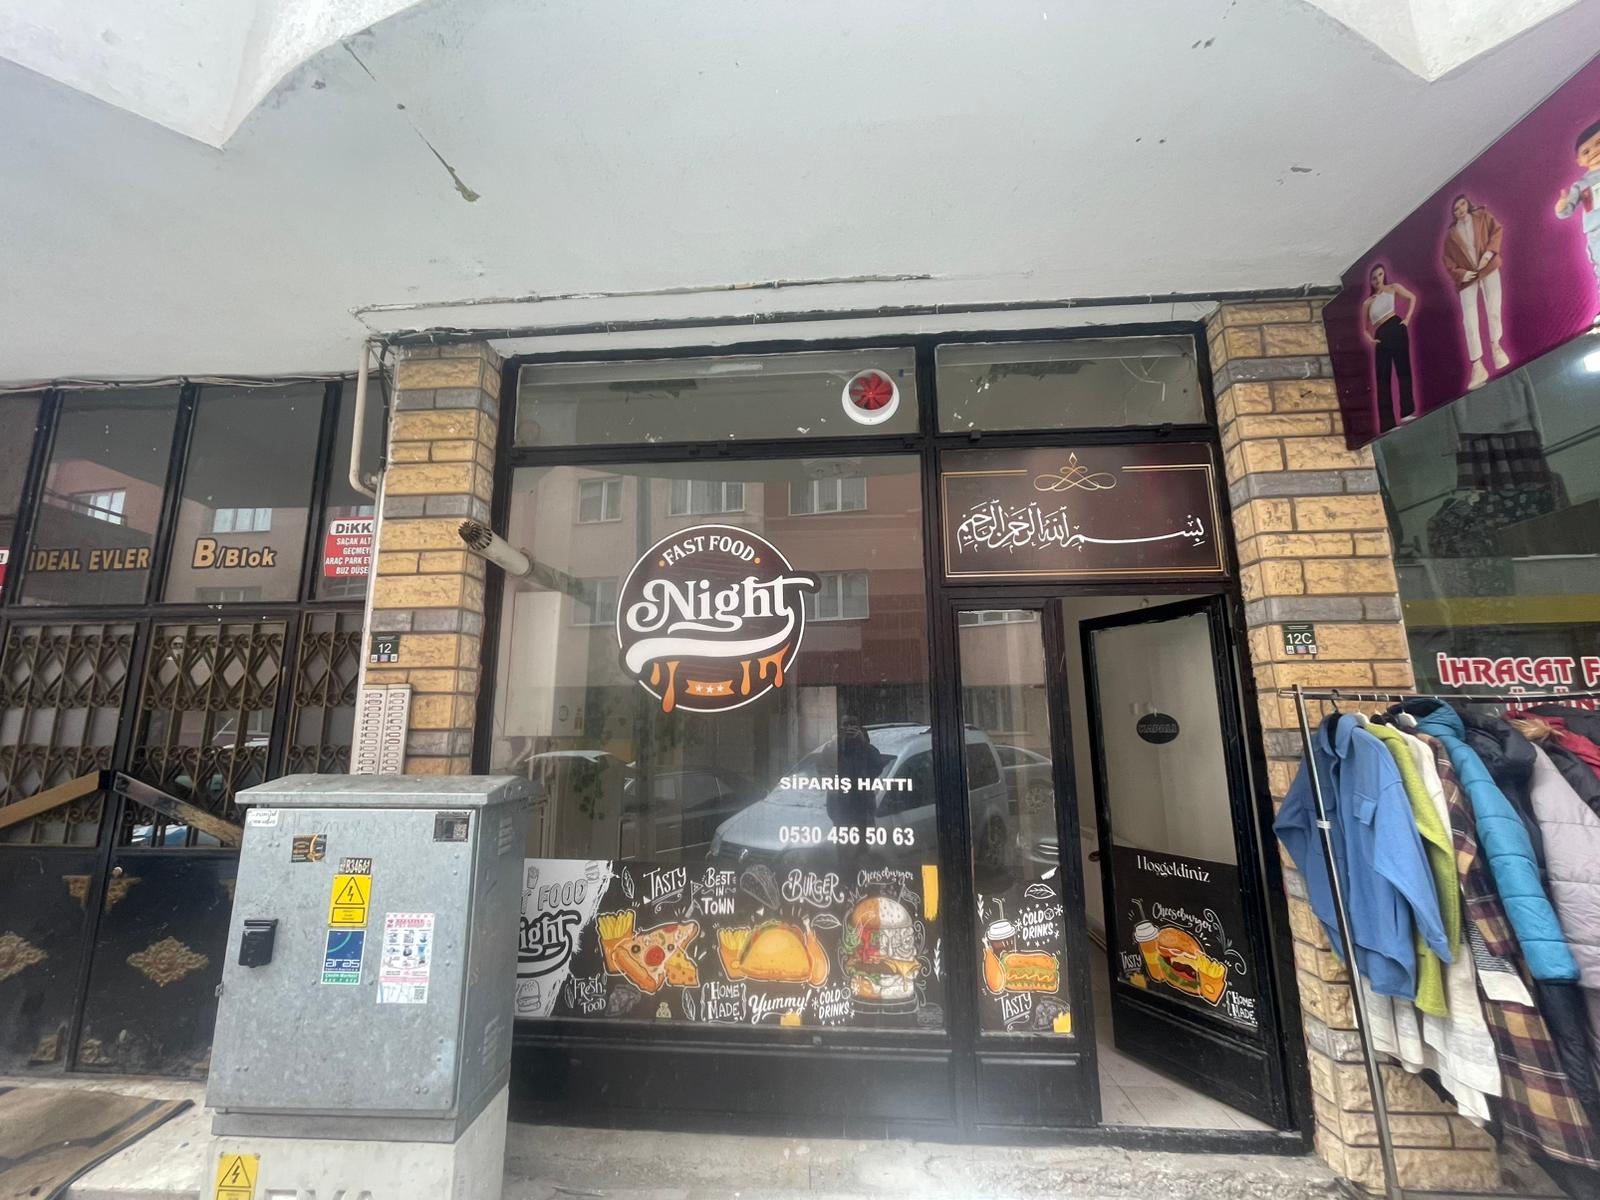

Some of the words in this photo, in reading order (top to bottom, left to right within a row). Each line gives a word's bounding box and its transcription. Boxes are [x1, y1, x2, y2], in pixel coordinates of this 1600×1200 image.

[88, 547, 151, 571] EVLER
[192, 538, 277, 568] B/Blok
[662, 536, 705, 567] FAST
[709, 535, 755, 562] FOOD
[325, 557, 343, 566] ARAÇ
[344, 557, 362, 565] PARK
[336, 567, 349, 575] BUZ
[626, 575, 815, 635] Night
[1286, 632, 1313, 645] 12C
[378, 643, 392, 654] 12
[1437, 652, 1575, 687] İHRACAT
[779, 774, 852, 794] SİPARİŞ
[857, 778, 914, 792] HATTI
[779, 826, 822, 844] 0530
[827, 826, 860, 845] 456
[865, 827, 888, 845] 50
[892, 827, 915, 846] 63
[643, 866, 687, 899] TASTY
[715, 885, 724, 896] IN
[782, 868, 844, 908] BURGER
[537, 879, 588, 912] FOOD
[1022, 911, 1044, 925] COLD
[1022, 924, 1053, 941] DRINKS
[325, 959, 360, 968] aras
[1120, 951, 1142, 971] TASTY
[710, 983, 740, 998] HOME
[819, 990, 841, 1004] COLD
[1231, 991, 1254, 1008] HOME
[708, 1001, 741, 1019] MADE
[749, 990, 812, 1024] Yummy!
[818, 1001, 850, 1015] DRINKS
[994, 992, 1032, 1020] TASTY
[1231, 1003, 1256, 1020] MADE
